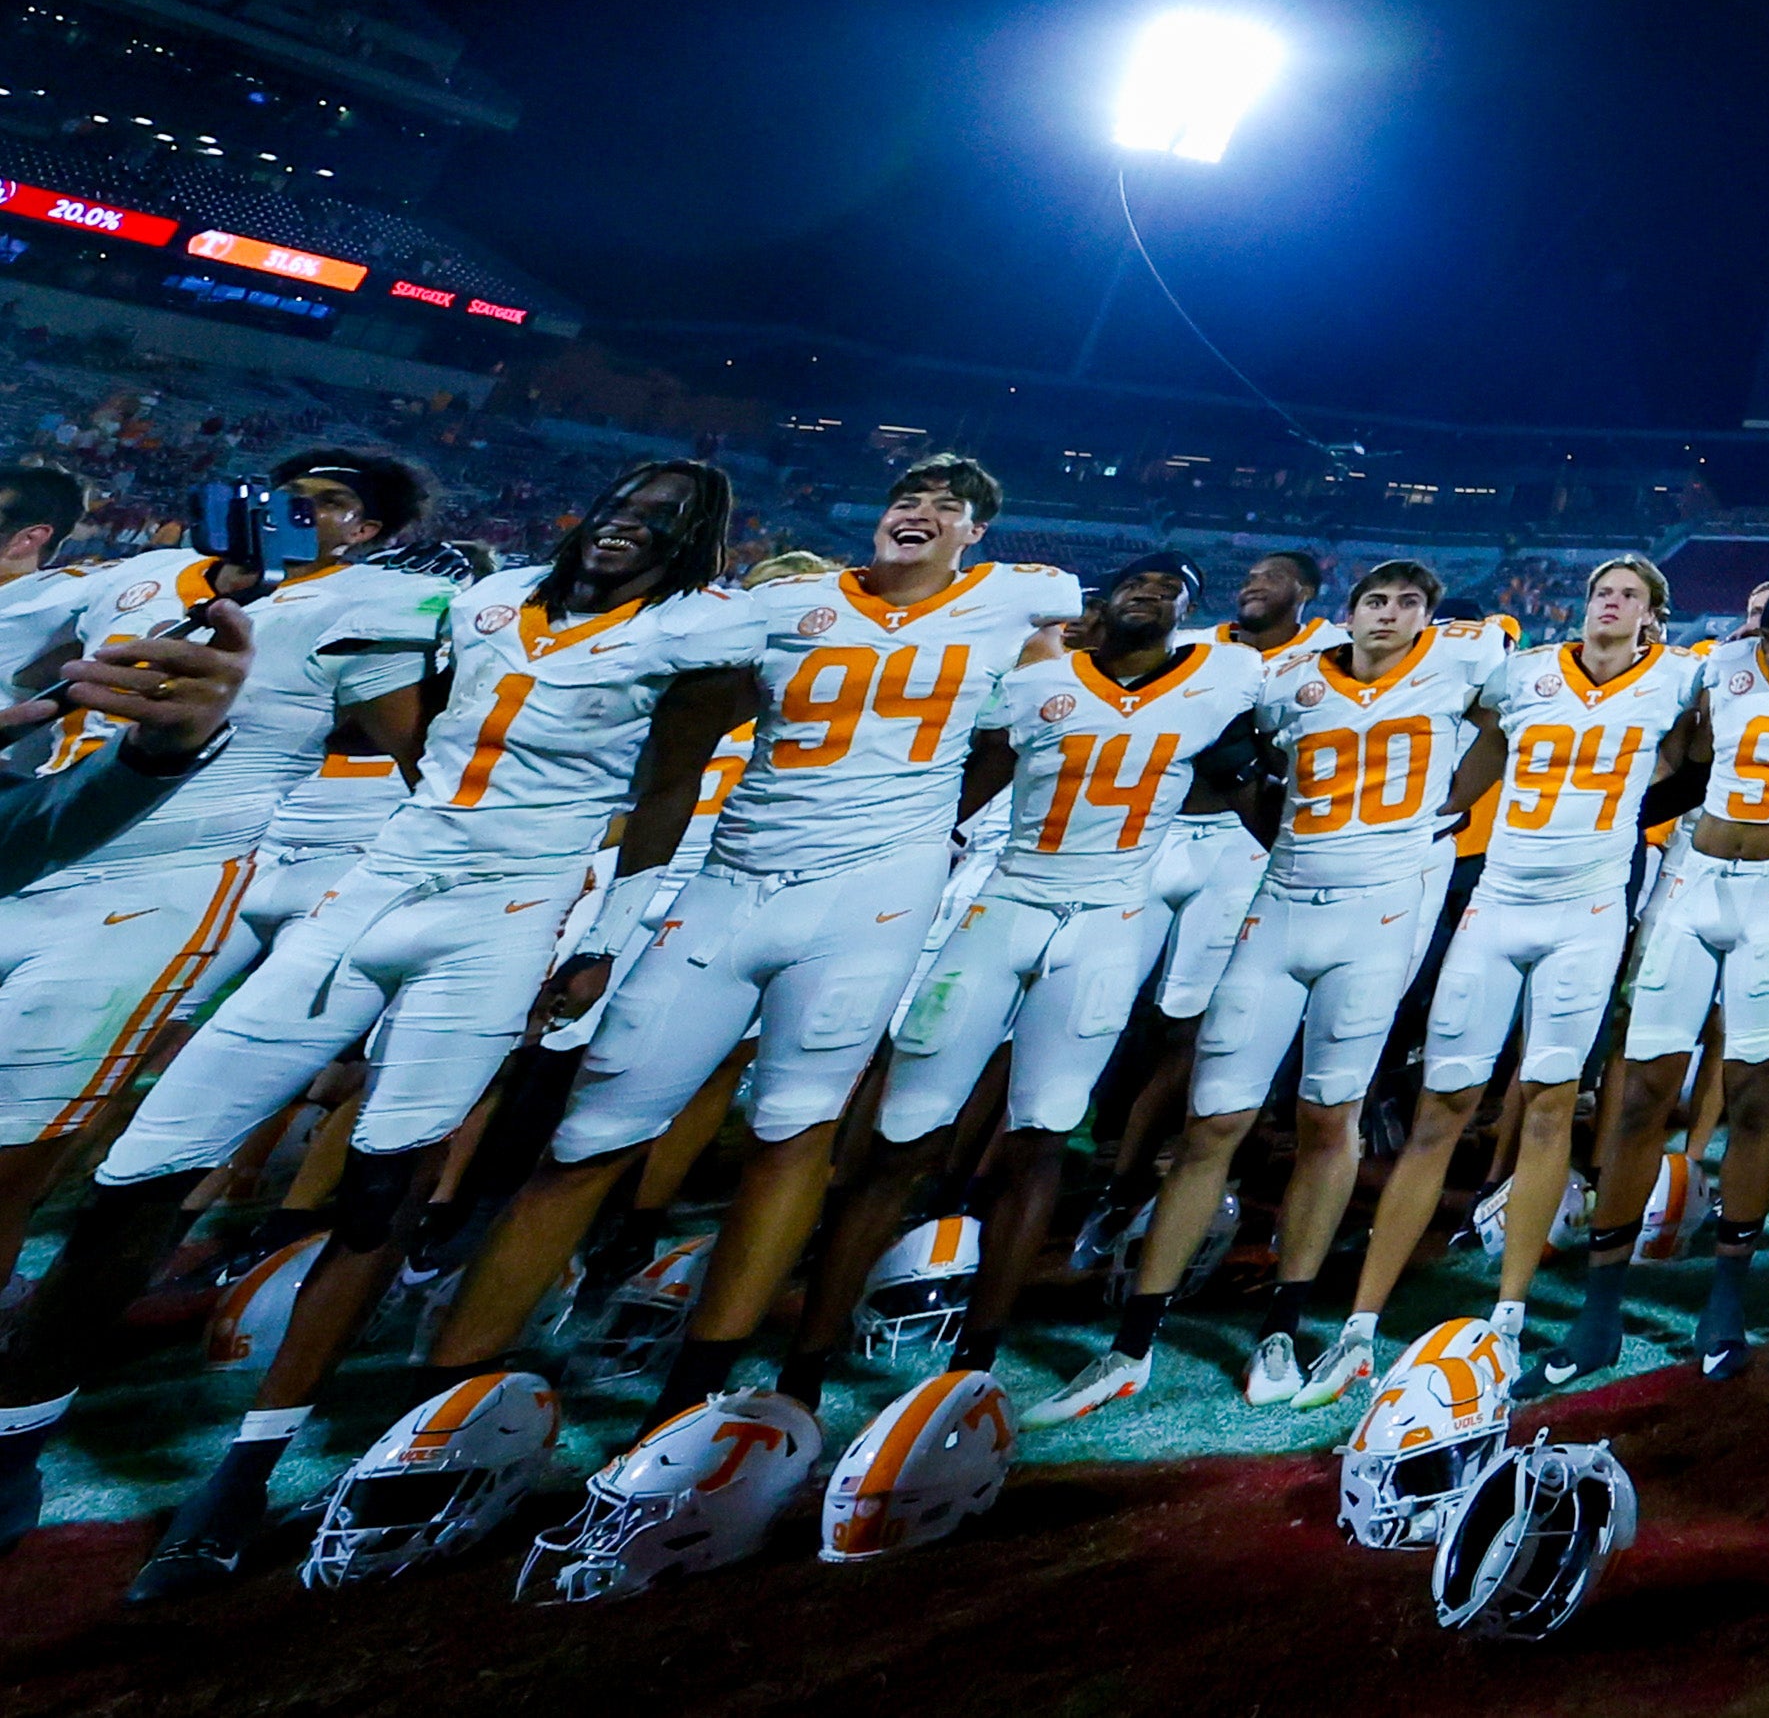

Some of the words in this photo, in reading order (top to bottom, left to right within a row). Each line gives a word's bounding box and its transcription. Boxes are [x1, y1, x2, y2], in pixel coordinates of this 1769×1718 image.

[48, 199, 122, 231] 20.0%
[262, 250, 321, 277] 31.6%
[391, 280, 456, 308] SEATGEEK
[468, 298, 528, 324] SEATGEEK
[885, 611, 908, 629] T
[531, 636, 555, 658] T
[770, 644, 970, 769] 94
[1120, 695, 1141, 714] T
[1358, 688, 1377, 707] T
[1586, 690, 1603, 707] T
[450, 673, 534, 807] 1
[1291, 715, 1431, 835] 90
[1505, 723, 1644, 831] 94
[1035, 733, 1180, 852] 14
[960, 904, 986, 932] T
[653, 920, 682, 948] T
[1454, 1413, 1484, 1431] VOLS
[697, 1421, 783, 1493] T
